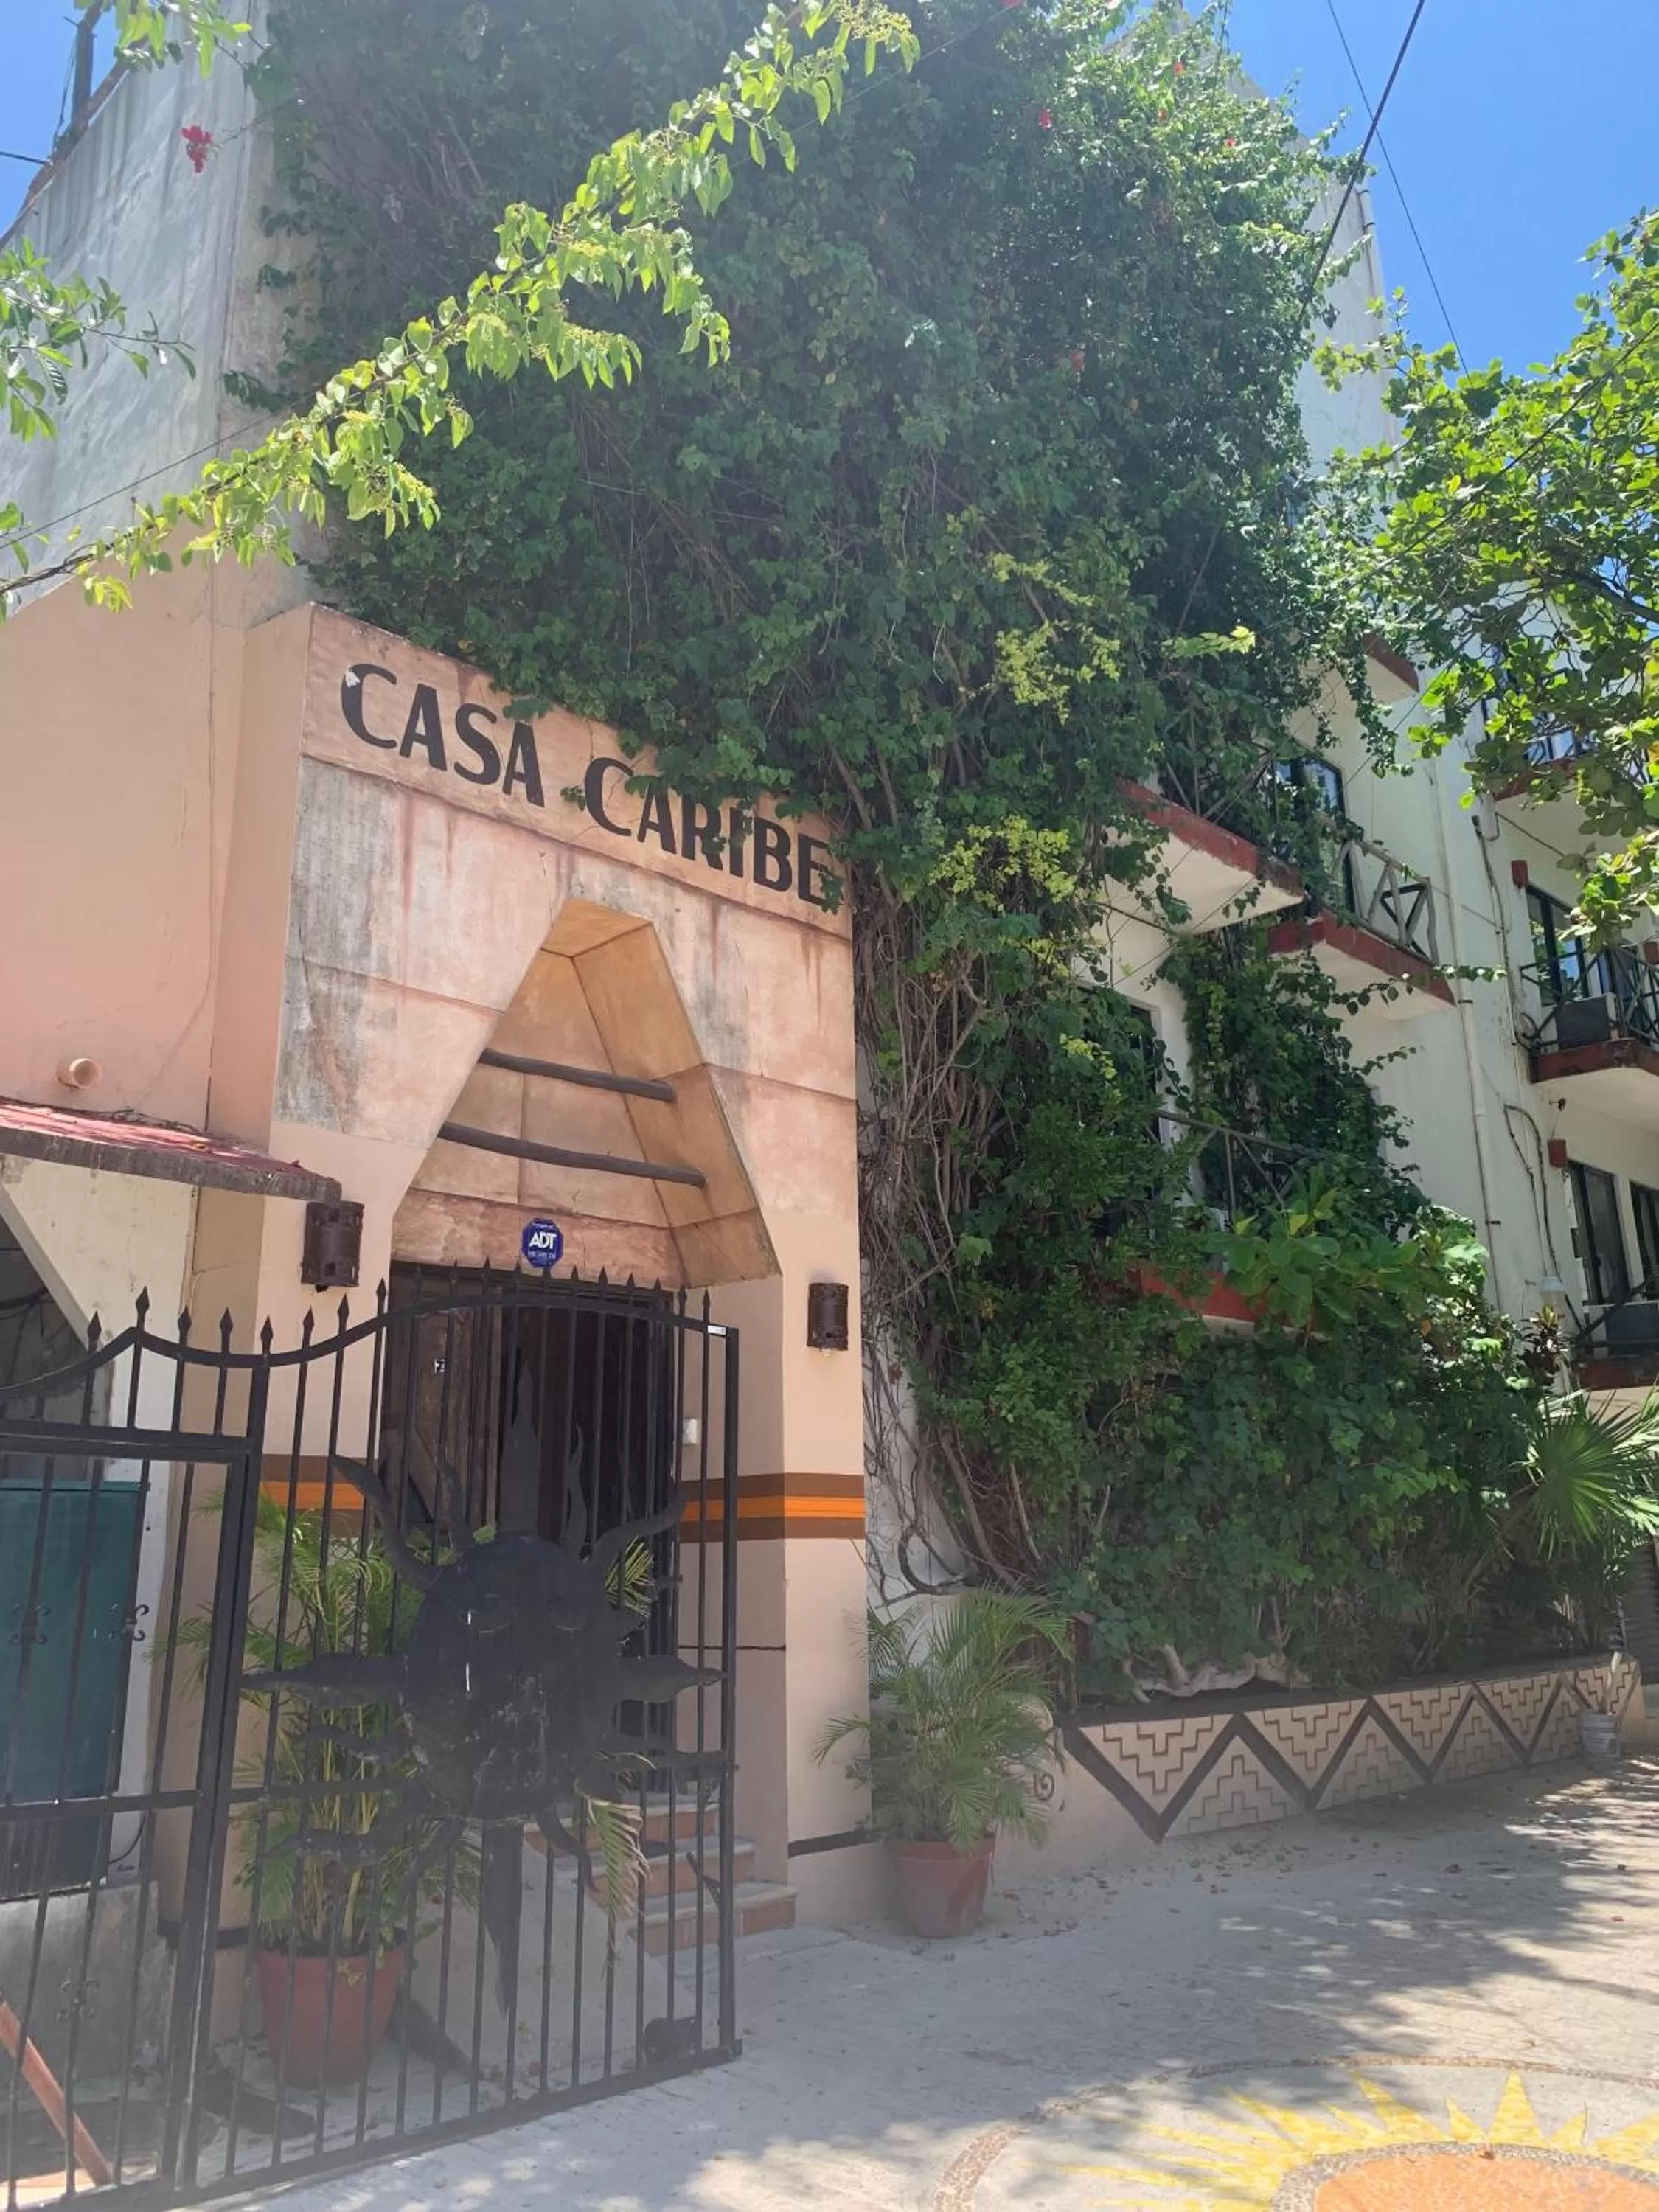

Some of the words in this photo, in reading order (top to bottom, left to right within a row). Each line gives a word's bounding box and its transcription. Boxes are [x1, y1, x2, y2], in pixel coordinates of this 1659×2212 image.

[341, 663, 545, 808] CASA
[584, 757, 844, 907] CARIBE
[529, 1231, 557, 1249] ADT
